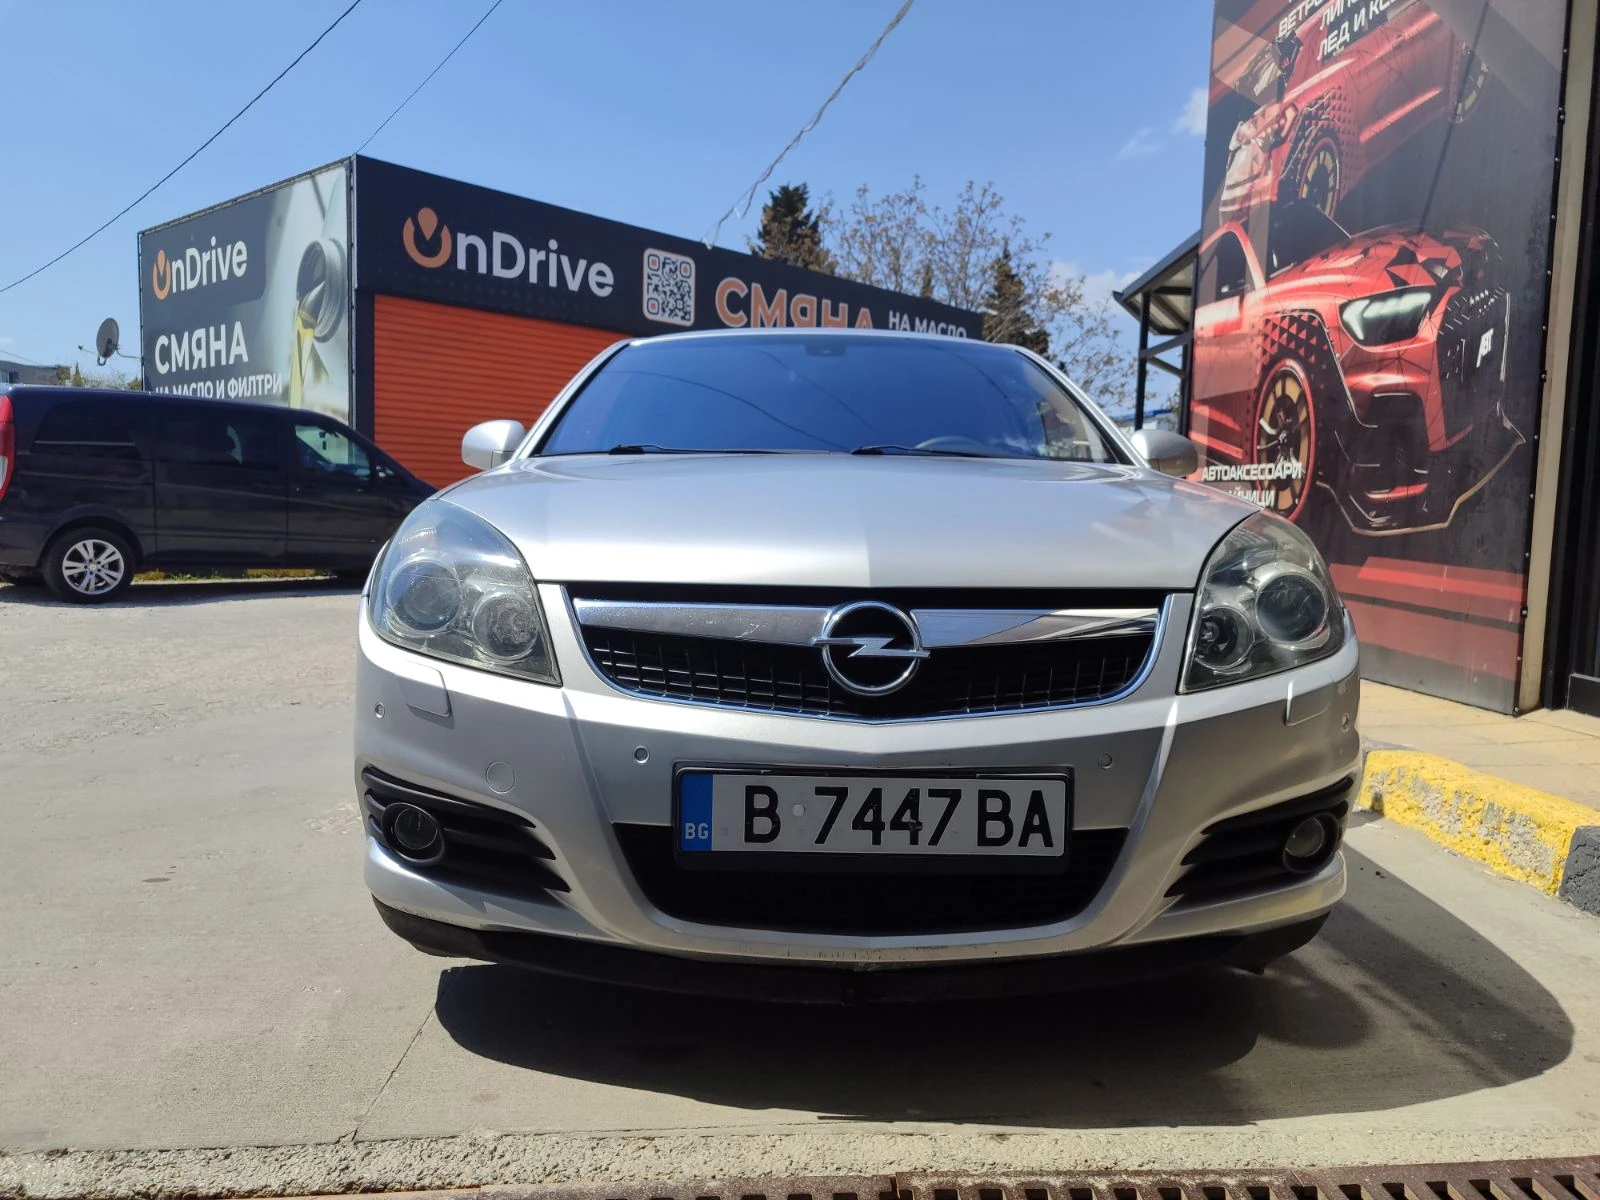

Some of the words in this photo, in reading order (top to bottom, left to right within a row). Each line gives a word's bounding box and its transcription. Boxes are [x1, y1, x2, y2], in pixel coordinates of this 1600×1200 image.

[1316, 20, 1350, 61] ЛЕД
[1353, 7, 1366, 32] И
[888, 310, 912, 332] НА
[154, 320, 248, 375] СМЯНА
[216, 378, 225, 399] И
[227, 373, 282, 399] ФИЛТРИ
[1202, 461, 1303, 482] АВТОАКСЕСОАРИ
[743, 785, 781, 844] B
[814, 786, 962, 846] 7447
[977, 789, 1053, 848] BA
[685, 822, 709, 841] BG
